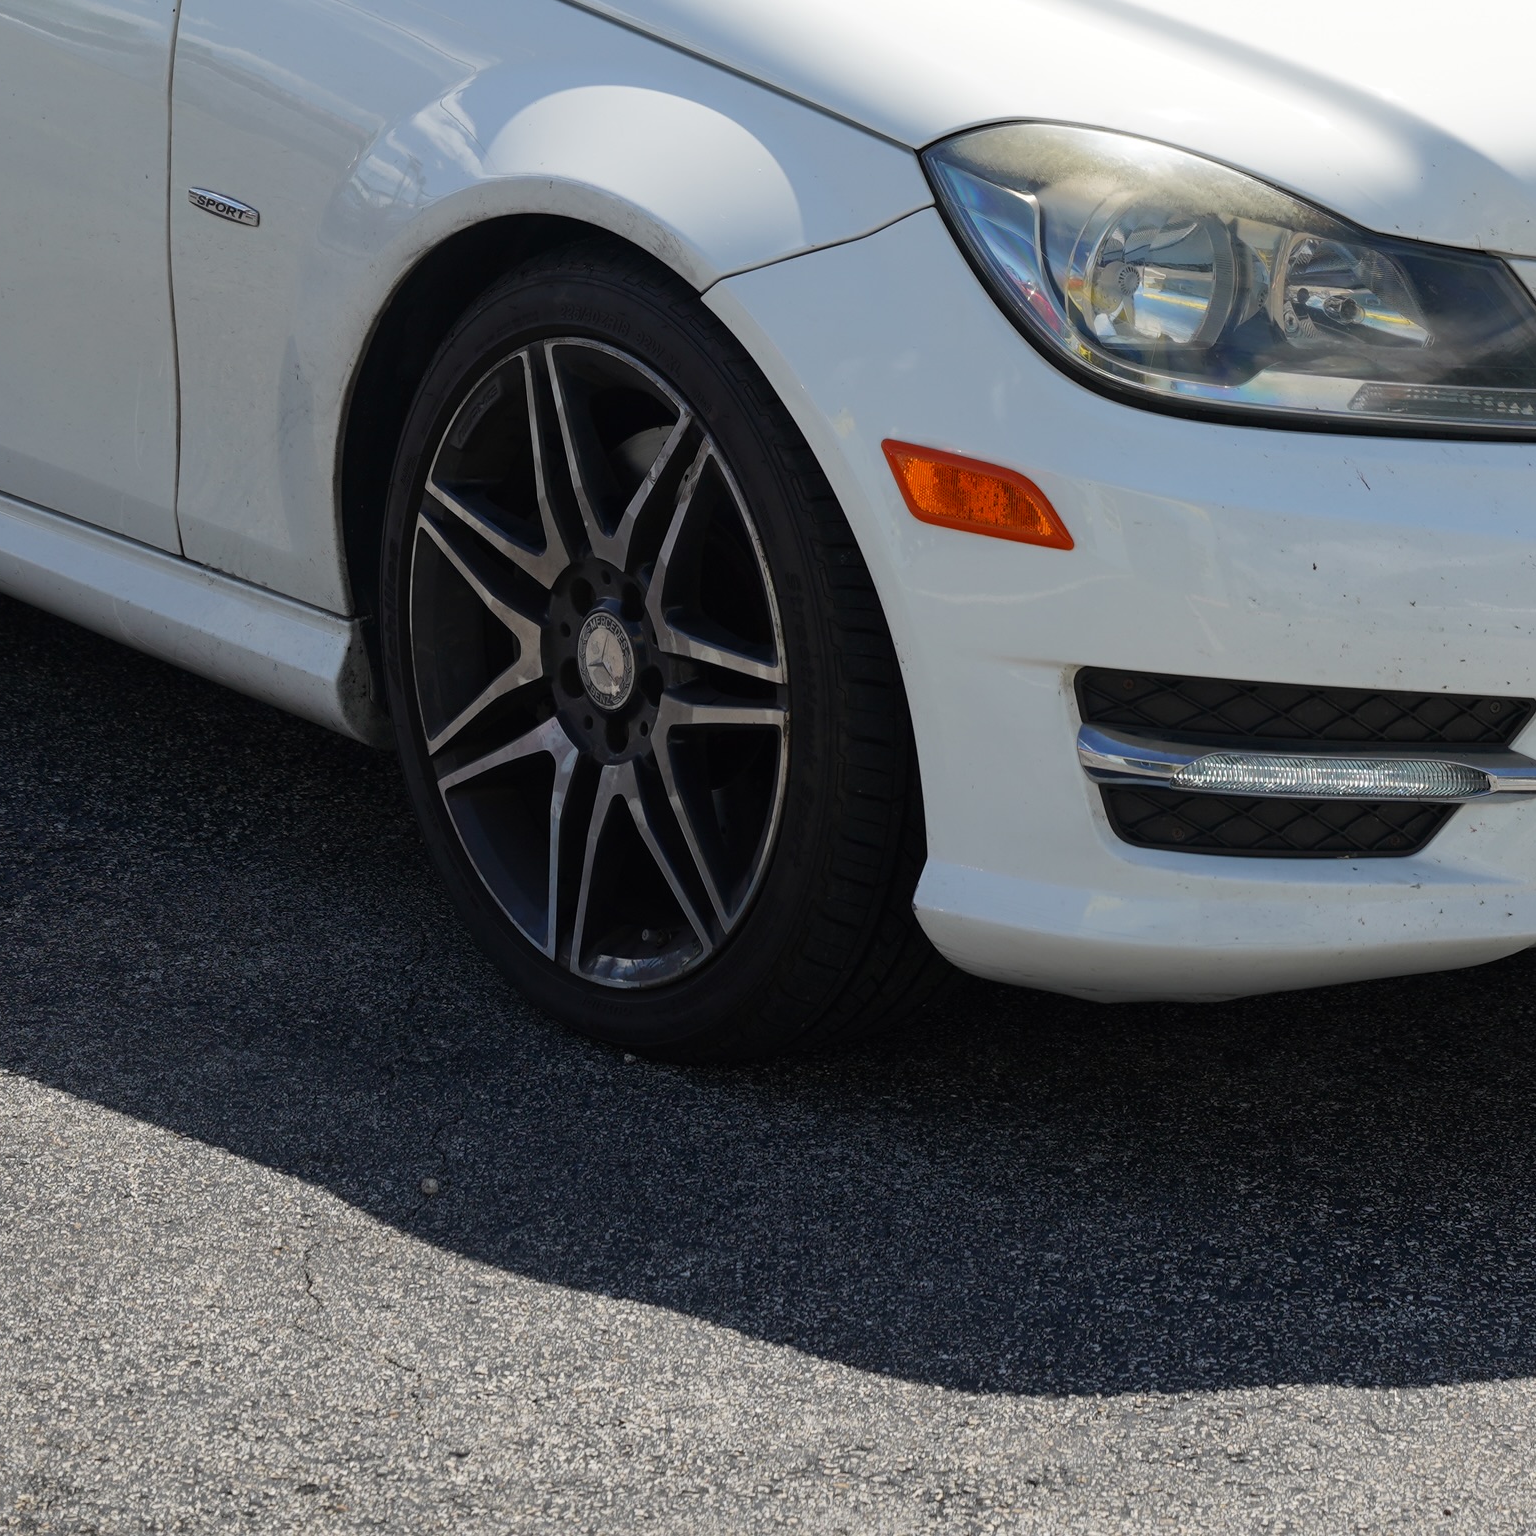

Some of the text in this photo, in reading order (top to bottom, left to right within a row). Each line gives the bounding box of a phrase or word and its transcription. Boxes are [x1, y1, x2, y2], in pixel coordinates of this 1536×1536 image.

[197, 195, 247, 220] SPORT
[589, 616, 628, 650] MERCEDES
[589, 687, 611, 705] BENZ
